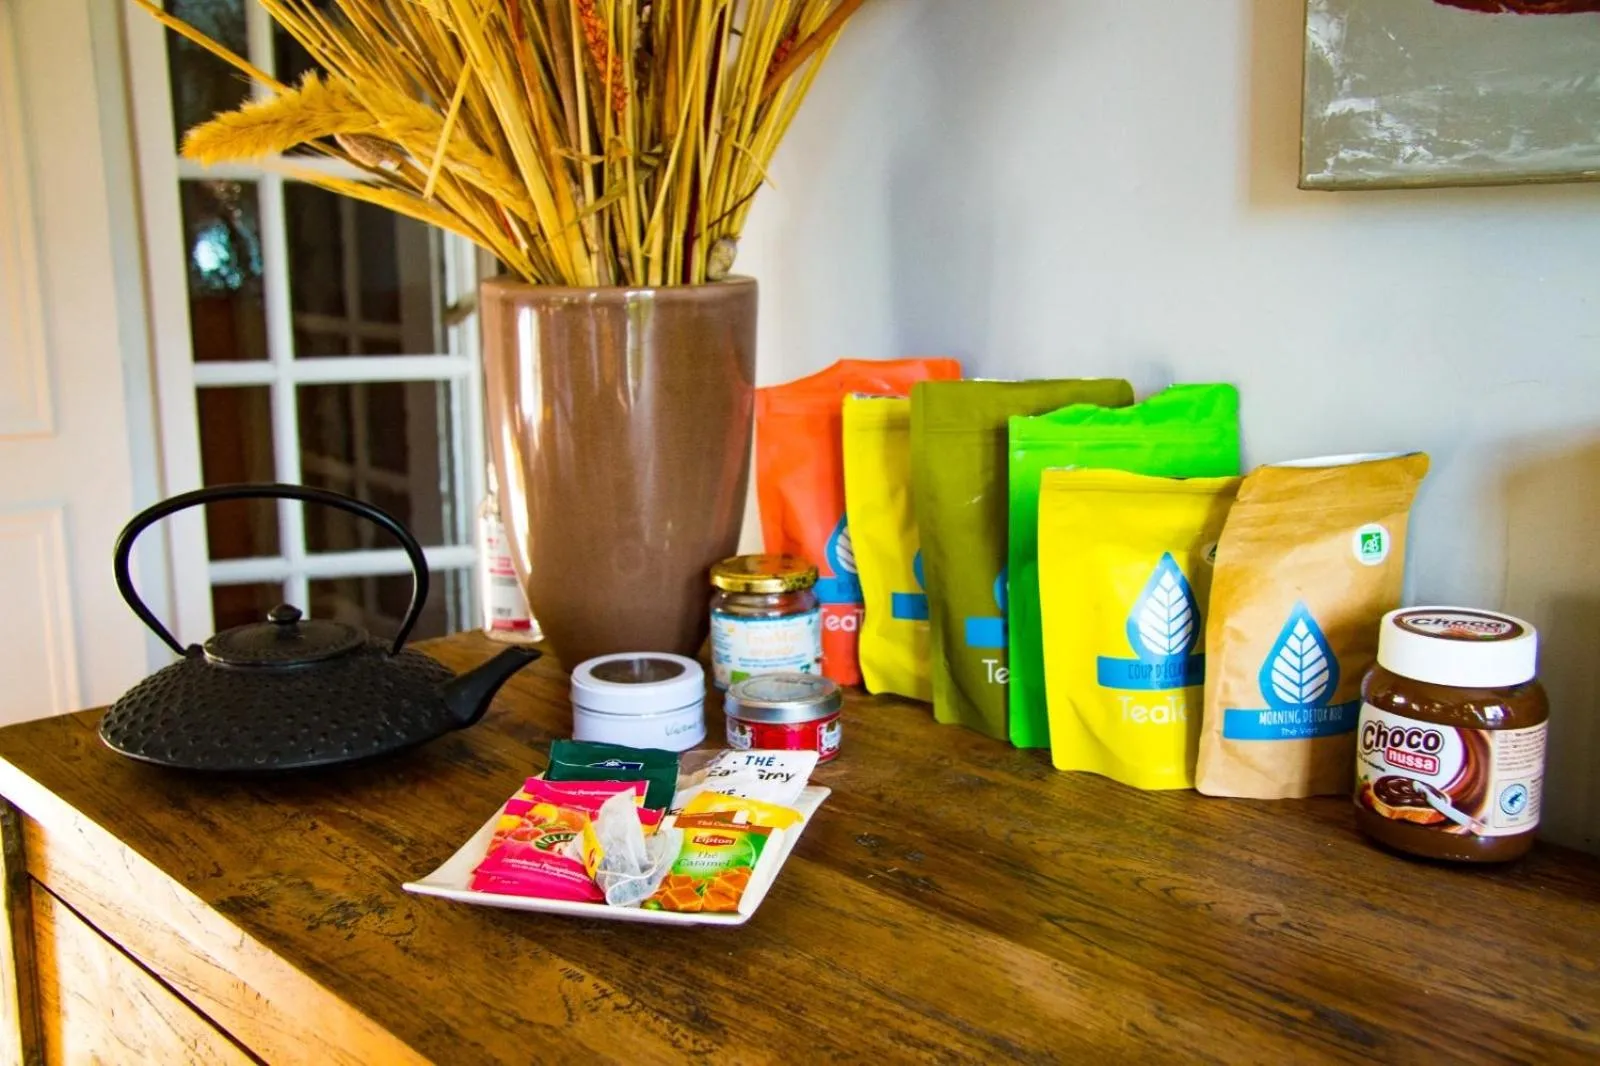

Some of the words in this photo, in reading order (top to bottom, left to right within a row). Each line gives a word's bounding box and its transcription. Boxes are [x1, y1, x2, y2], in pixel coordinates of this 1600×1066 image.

[1258, 709, 1301, 726] MORNING
[1302, 706, 1328, 724] DETOX
[1362, 722, 1442, 752] Choco
[1388, 748, 1434, 771] nussa
[695, 835, 734, 846] Lipton
